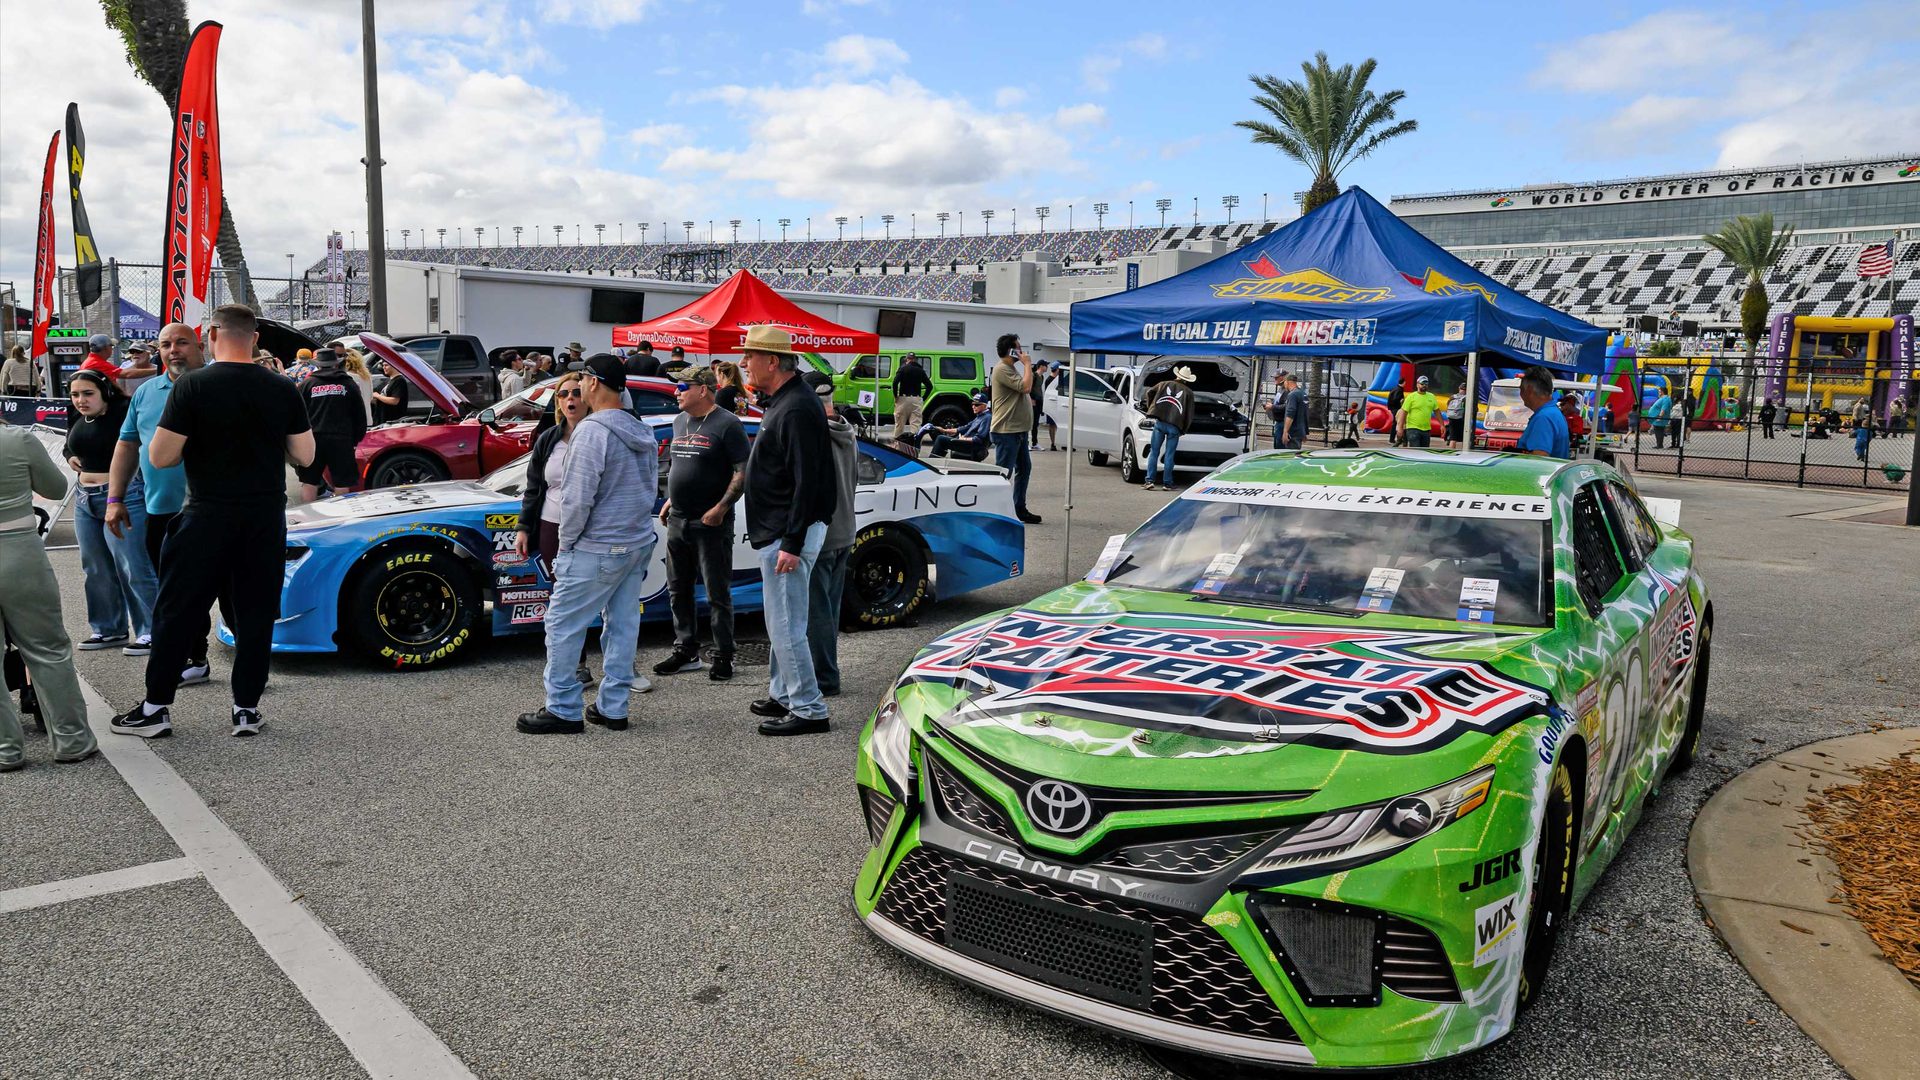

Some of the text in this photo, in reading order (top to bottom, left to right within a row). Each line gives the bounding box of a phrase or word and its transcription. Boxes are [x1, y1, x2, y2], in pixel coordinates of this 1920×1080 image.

[1531, 168, 1876, 206] WORLD CENTER OF RACING
[170, 112, 193, 324] DAYTONA
[1232, 279, 1383, 303] SUNOCO
[48, 329, 87, 337] ATM
[627, 330, 693, 346] DaytonaDodge.com
[1143, 320, 1252, 341] OFFICIAL FUEL
[1289, 320, 1373, 345] NASCAR
[1777, 316, 1790, 353] FIELD
[4, 401, 18, 412] V8
[1210, 486, 1545, 513] NASCAR RACING EXPERIENCE
[386, 553, 432, 571] EAGLE
[501, 591, 549, 600] MOTHERS
[968, 616, 1500, 707] INTERSTATE
[936, 637, 1422, 728] BATTERIES
[965, 840, 1145, 897] CAMRY
[1459, 847, 1522, 893] JGR
[1477, 897, 1516, 946] WIX
[1476, 930, 1518, 966] FILTERS
